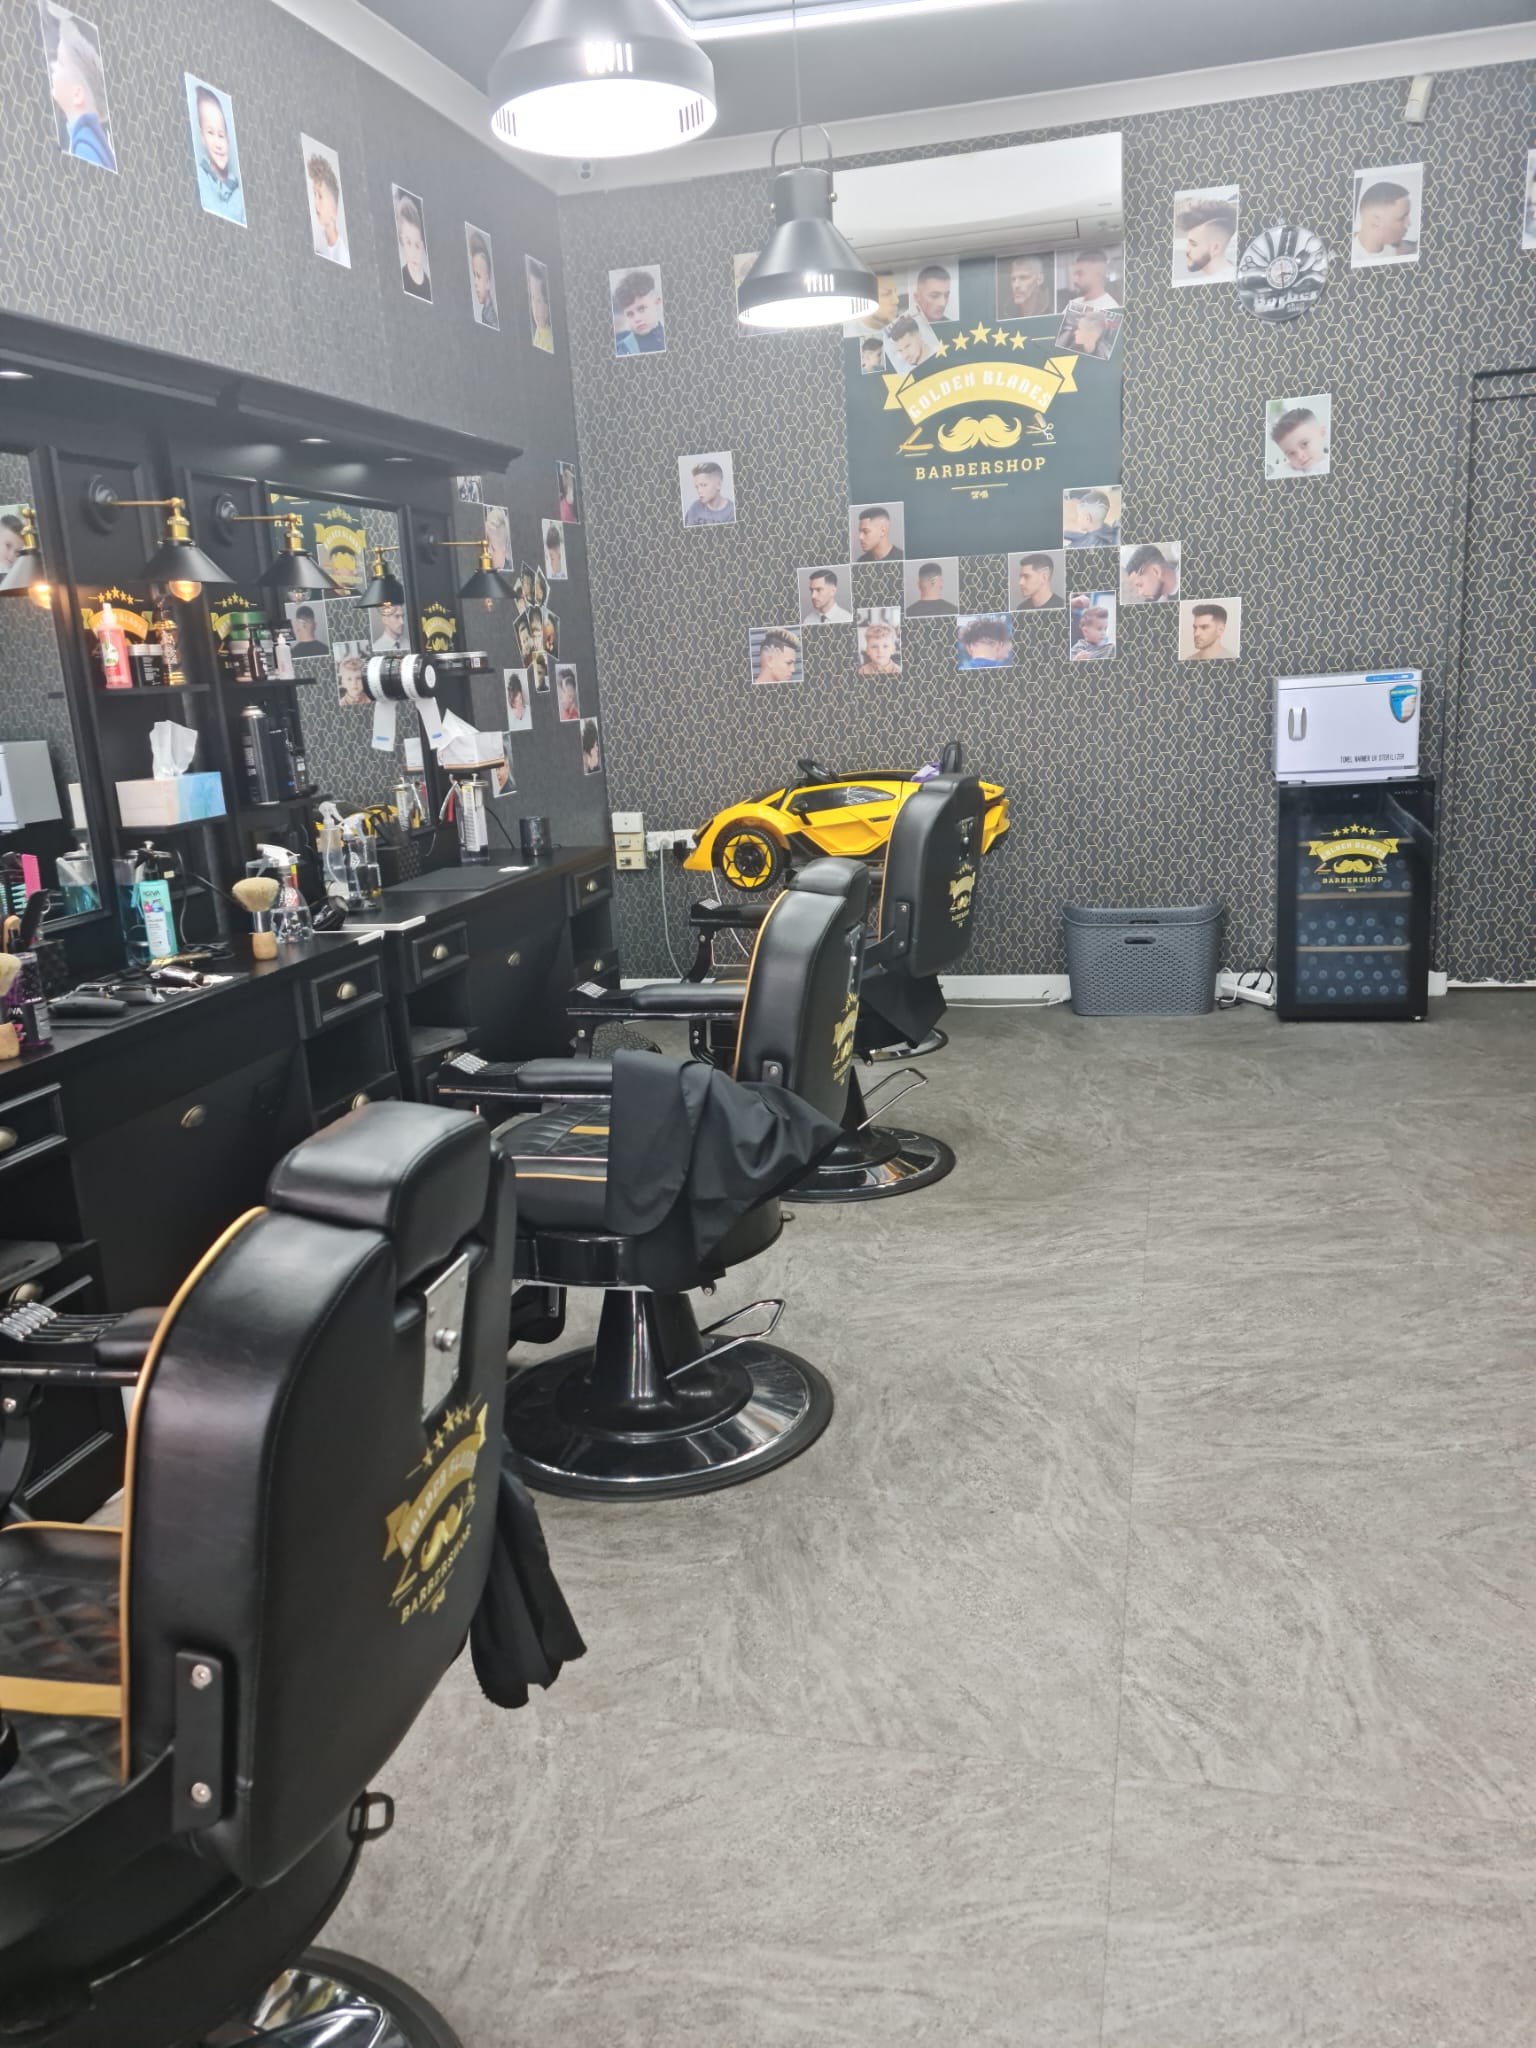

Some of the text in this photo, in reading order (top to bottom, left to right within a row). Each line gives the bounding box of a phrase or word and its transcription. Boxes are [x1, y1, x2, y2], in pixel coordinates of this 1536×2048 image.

[908, 369, 1053, 420] GOLDEN BLADES
[915, 457, 1047, 481] BARBERSHOP
[1322, 876, 1384, 884] BARBERSHOP
